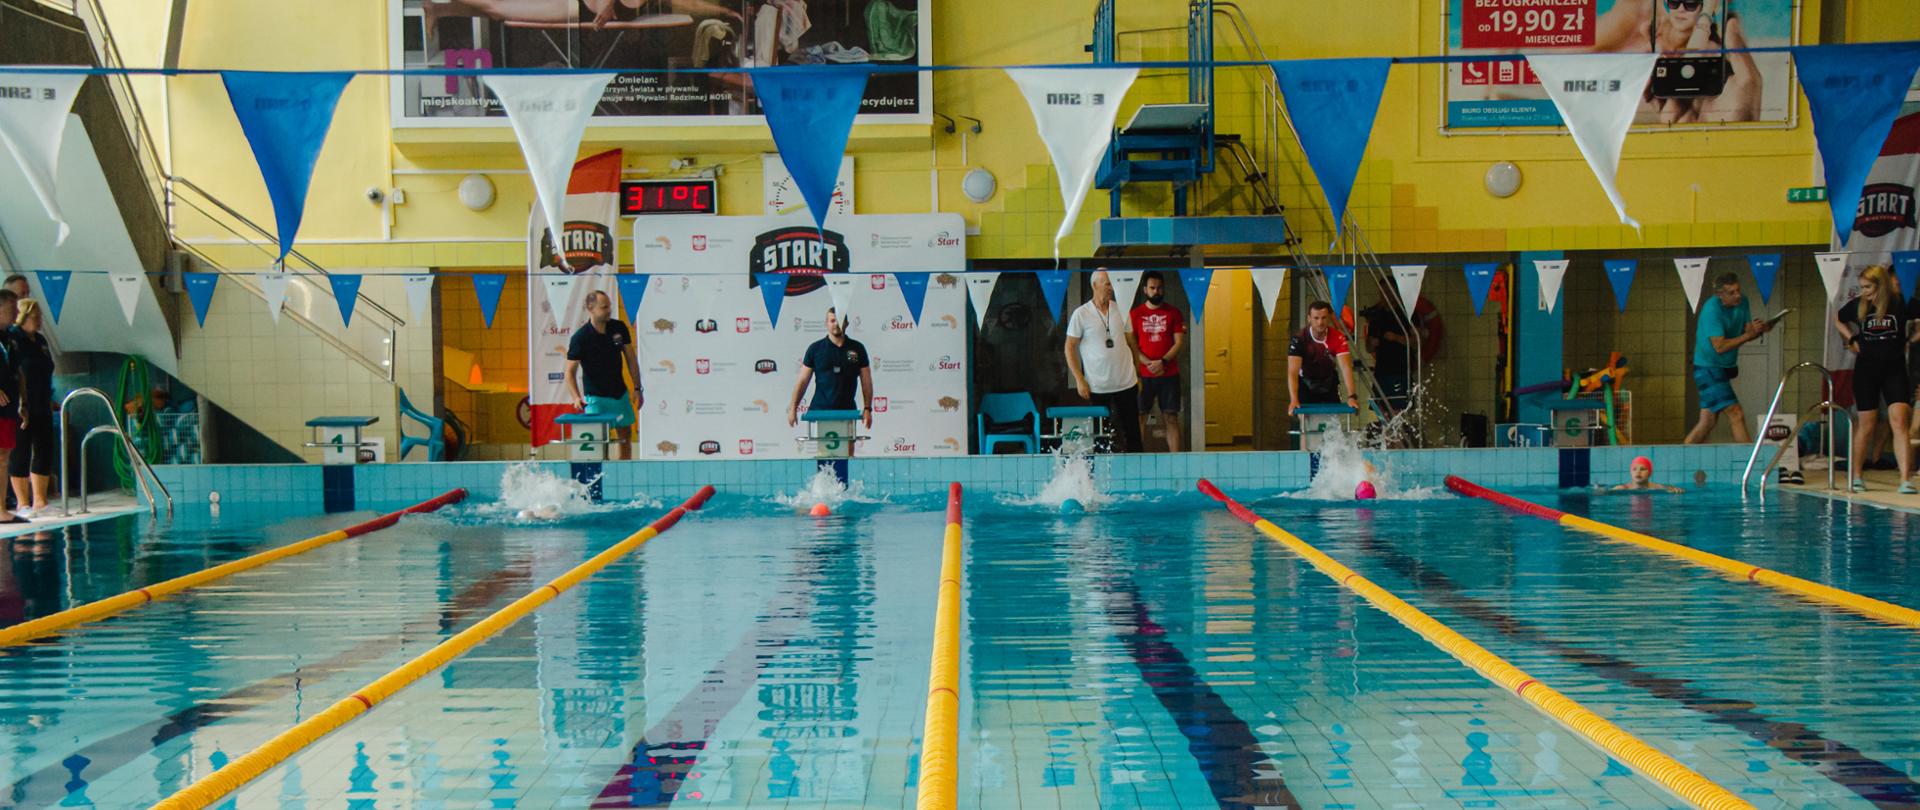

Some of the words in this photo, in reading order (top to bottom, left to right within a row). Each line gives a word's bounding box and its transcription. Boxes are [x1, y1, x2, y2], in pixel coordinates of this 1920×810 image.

[1478, 24, 1491, 32] OD
[1489, 9, 1556, 35] 19,90
[1562, 7, 1585, 31] zł
[1525, 34, 1582, 45] MIESIĘCZNIE
[421, 96, 501, 108] miejskoaktyw
[860, 97, 915, 107] ecydujesz
[1857, 191, 1909, 217] START
[551, 229, 604, 255] TART
[937, 236, 960, 246] Start
[764, 239, 837, 272] START
[891, 320, 914, 330] Start
[938, 360, 961, 370] Start
[1565, 417, 1582, 437] 6
[332, 434, 343, 453] 1
[579, 432, 595, 451] 2
[825, 431, 840, 450] 3
[893, 442, 916, 451] Start
